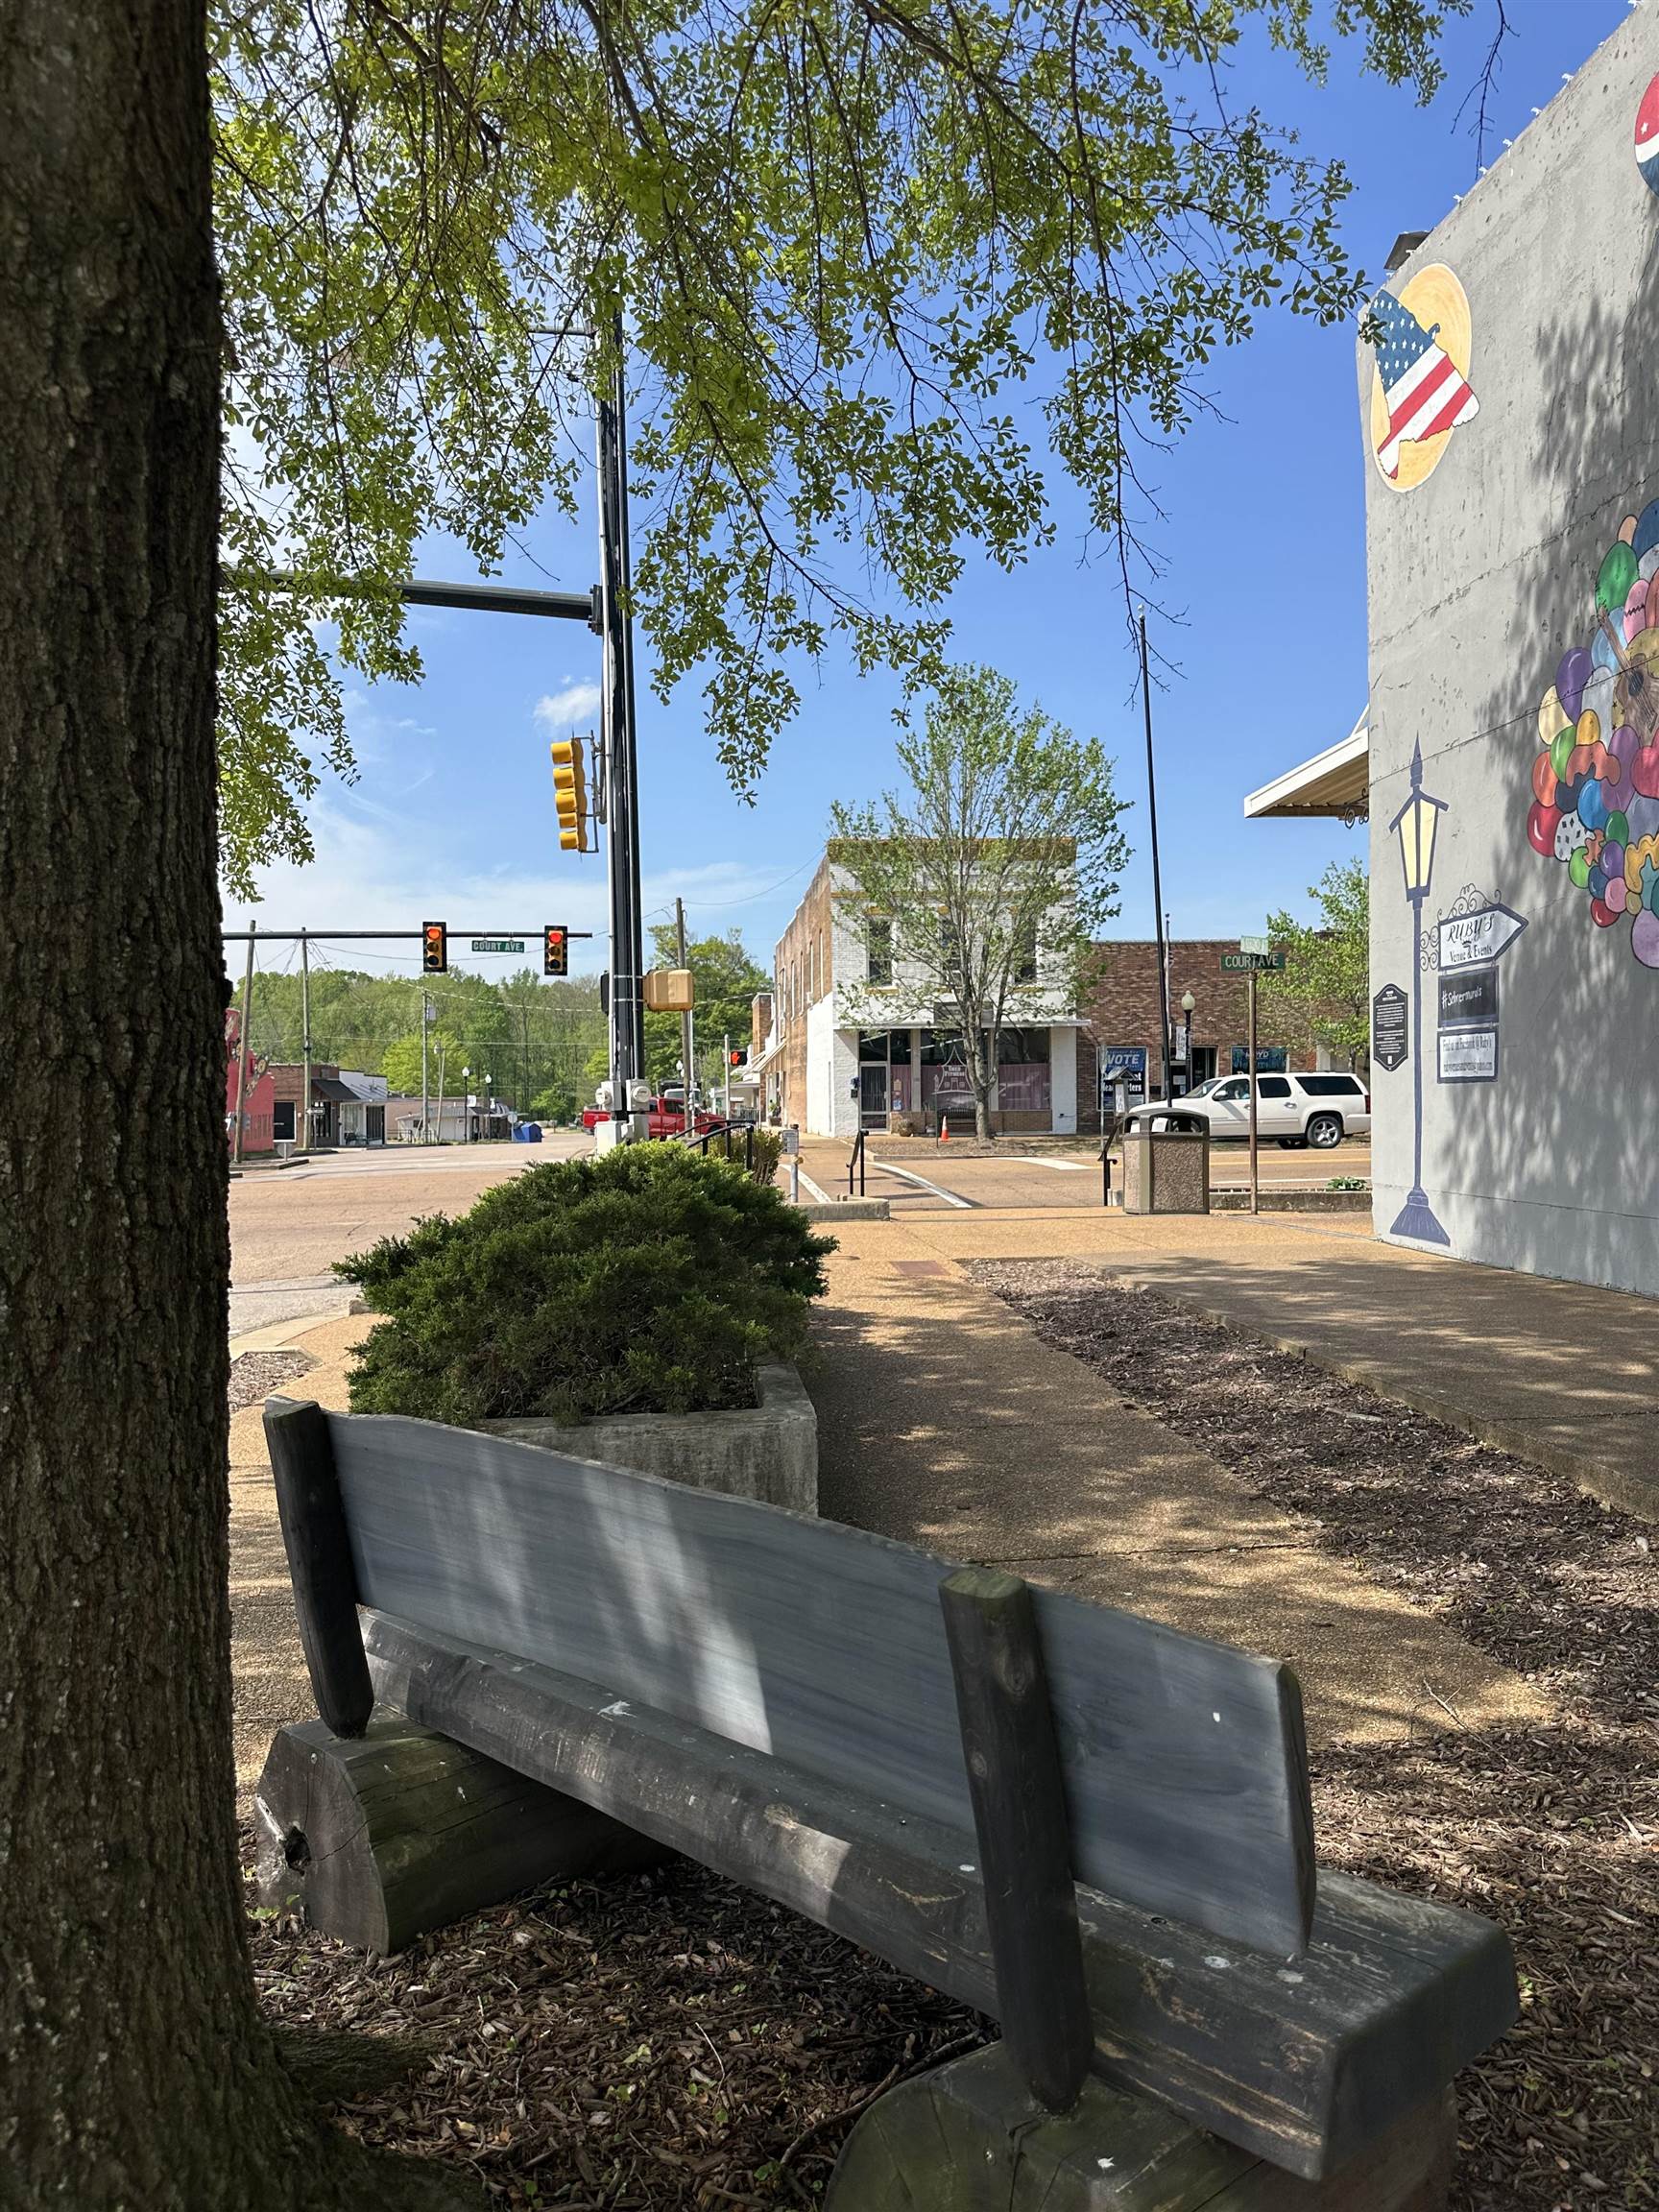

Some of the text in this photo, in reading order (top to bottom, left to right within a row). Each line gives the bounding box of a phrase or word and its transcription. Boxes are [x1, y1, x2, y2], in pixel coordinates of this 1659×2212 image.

[1447, 913, 1495, 943] RUBY'S
[472, 942, 523, 951] COURT AVE.
[1450, 950, 1466, 962] Venue
[1474, 944, 1492, 958] Events
[1225, 954, 1279, 968] COURT AVE
[1107, 1054, 1140, 1065] VOTE
